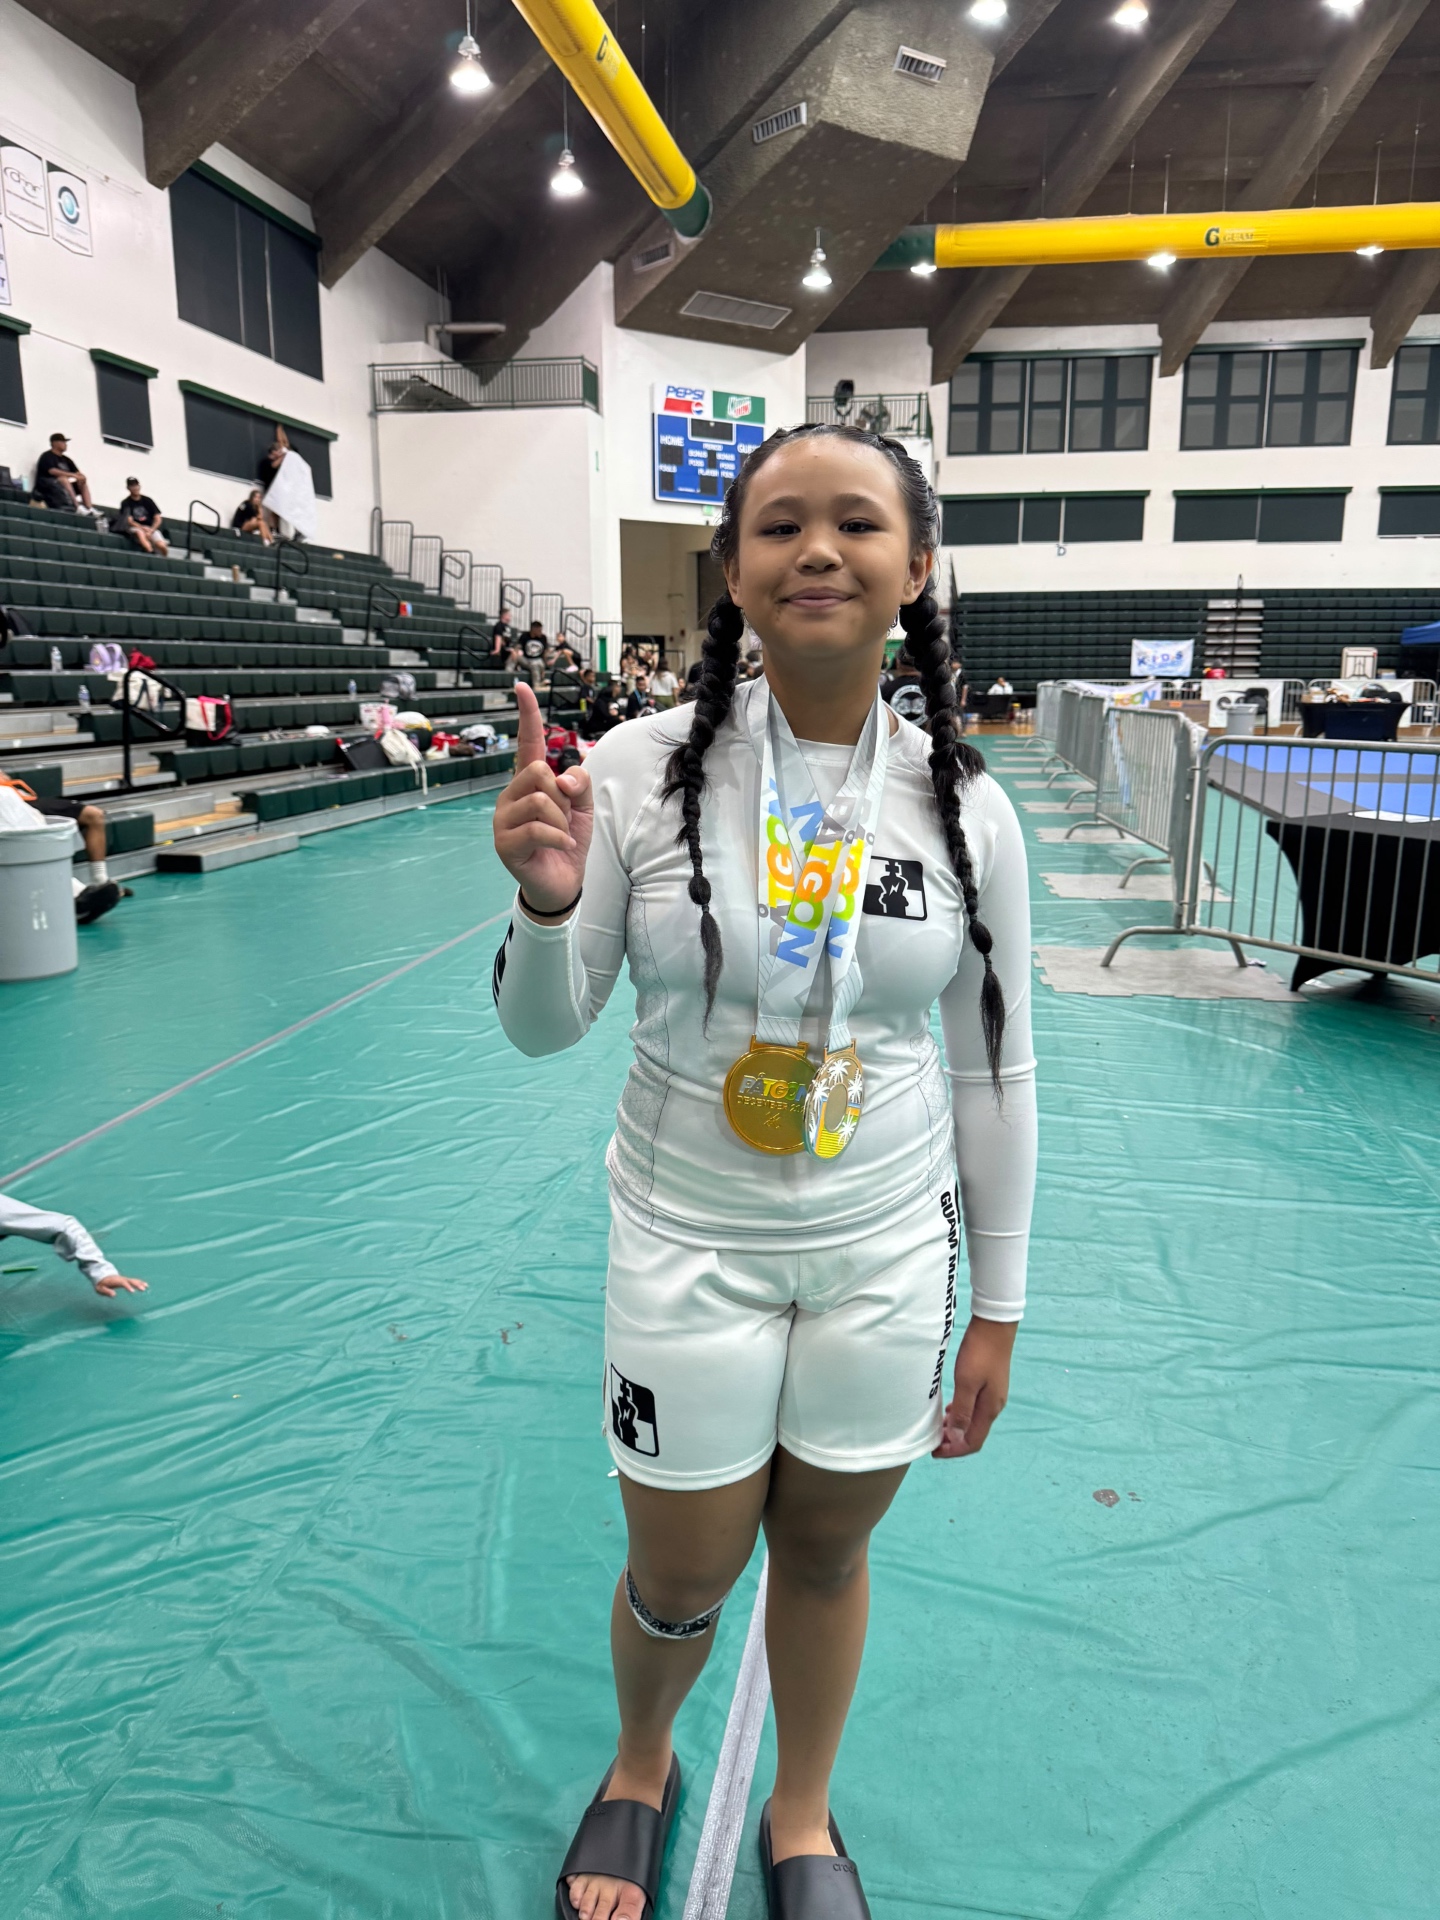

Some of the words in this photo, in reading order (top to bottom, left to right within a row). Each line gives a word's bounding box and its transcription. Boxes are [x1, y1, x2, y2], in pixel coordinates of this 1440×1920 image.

[666, 385, 705, 400] PEPSI
[660, 435, 684, 447] HOME
[737, 443, 761, 453] GUE
[940, 1191, 958, 1250] GUAM
